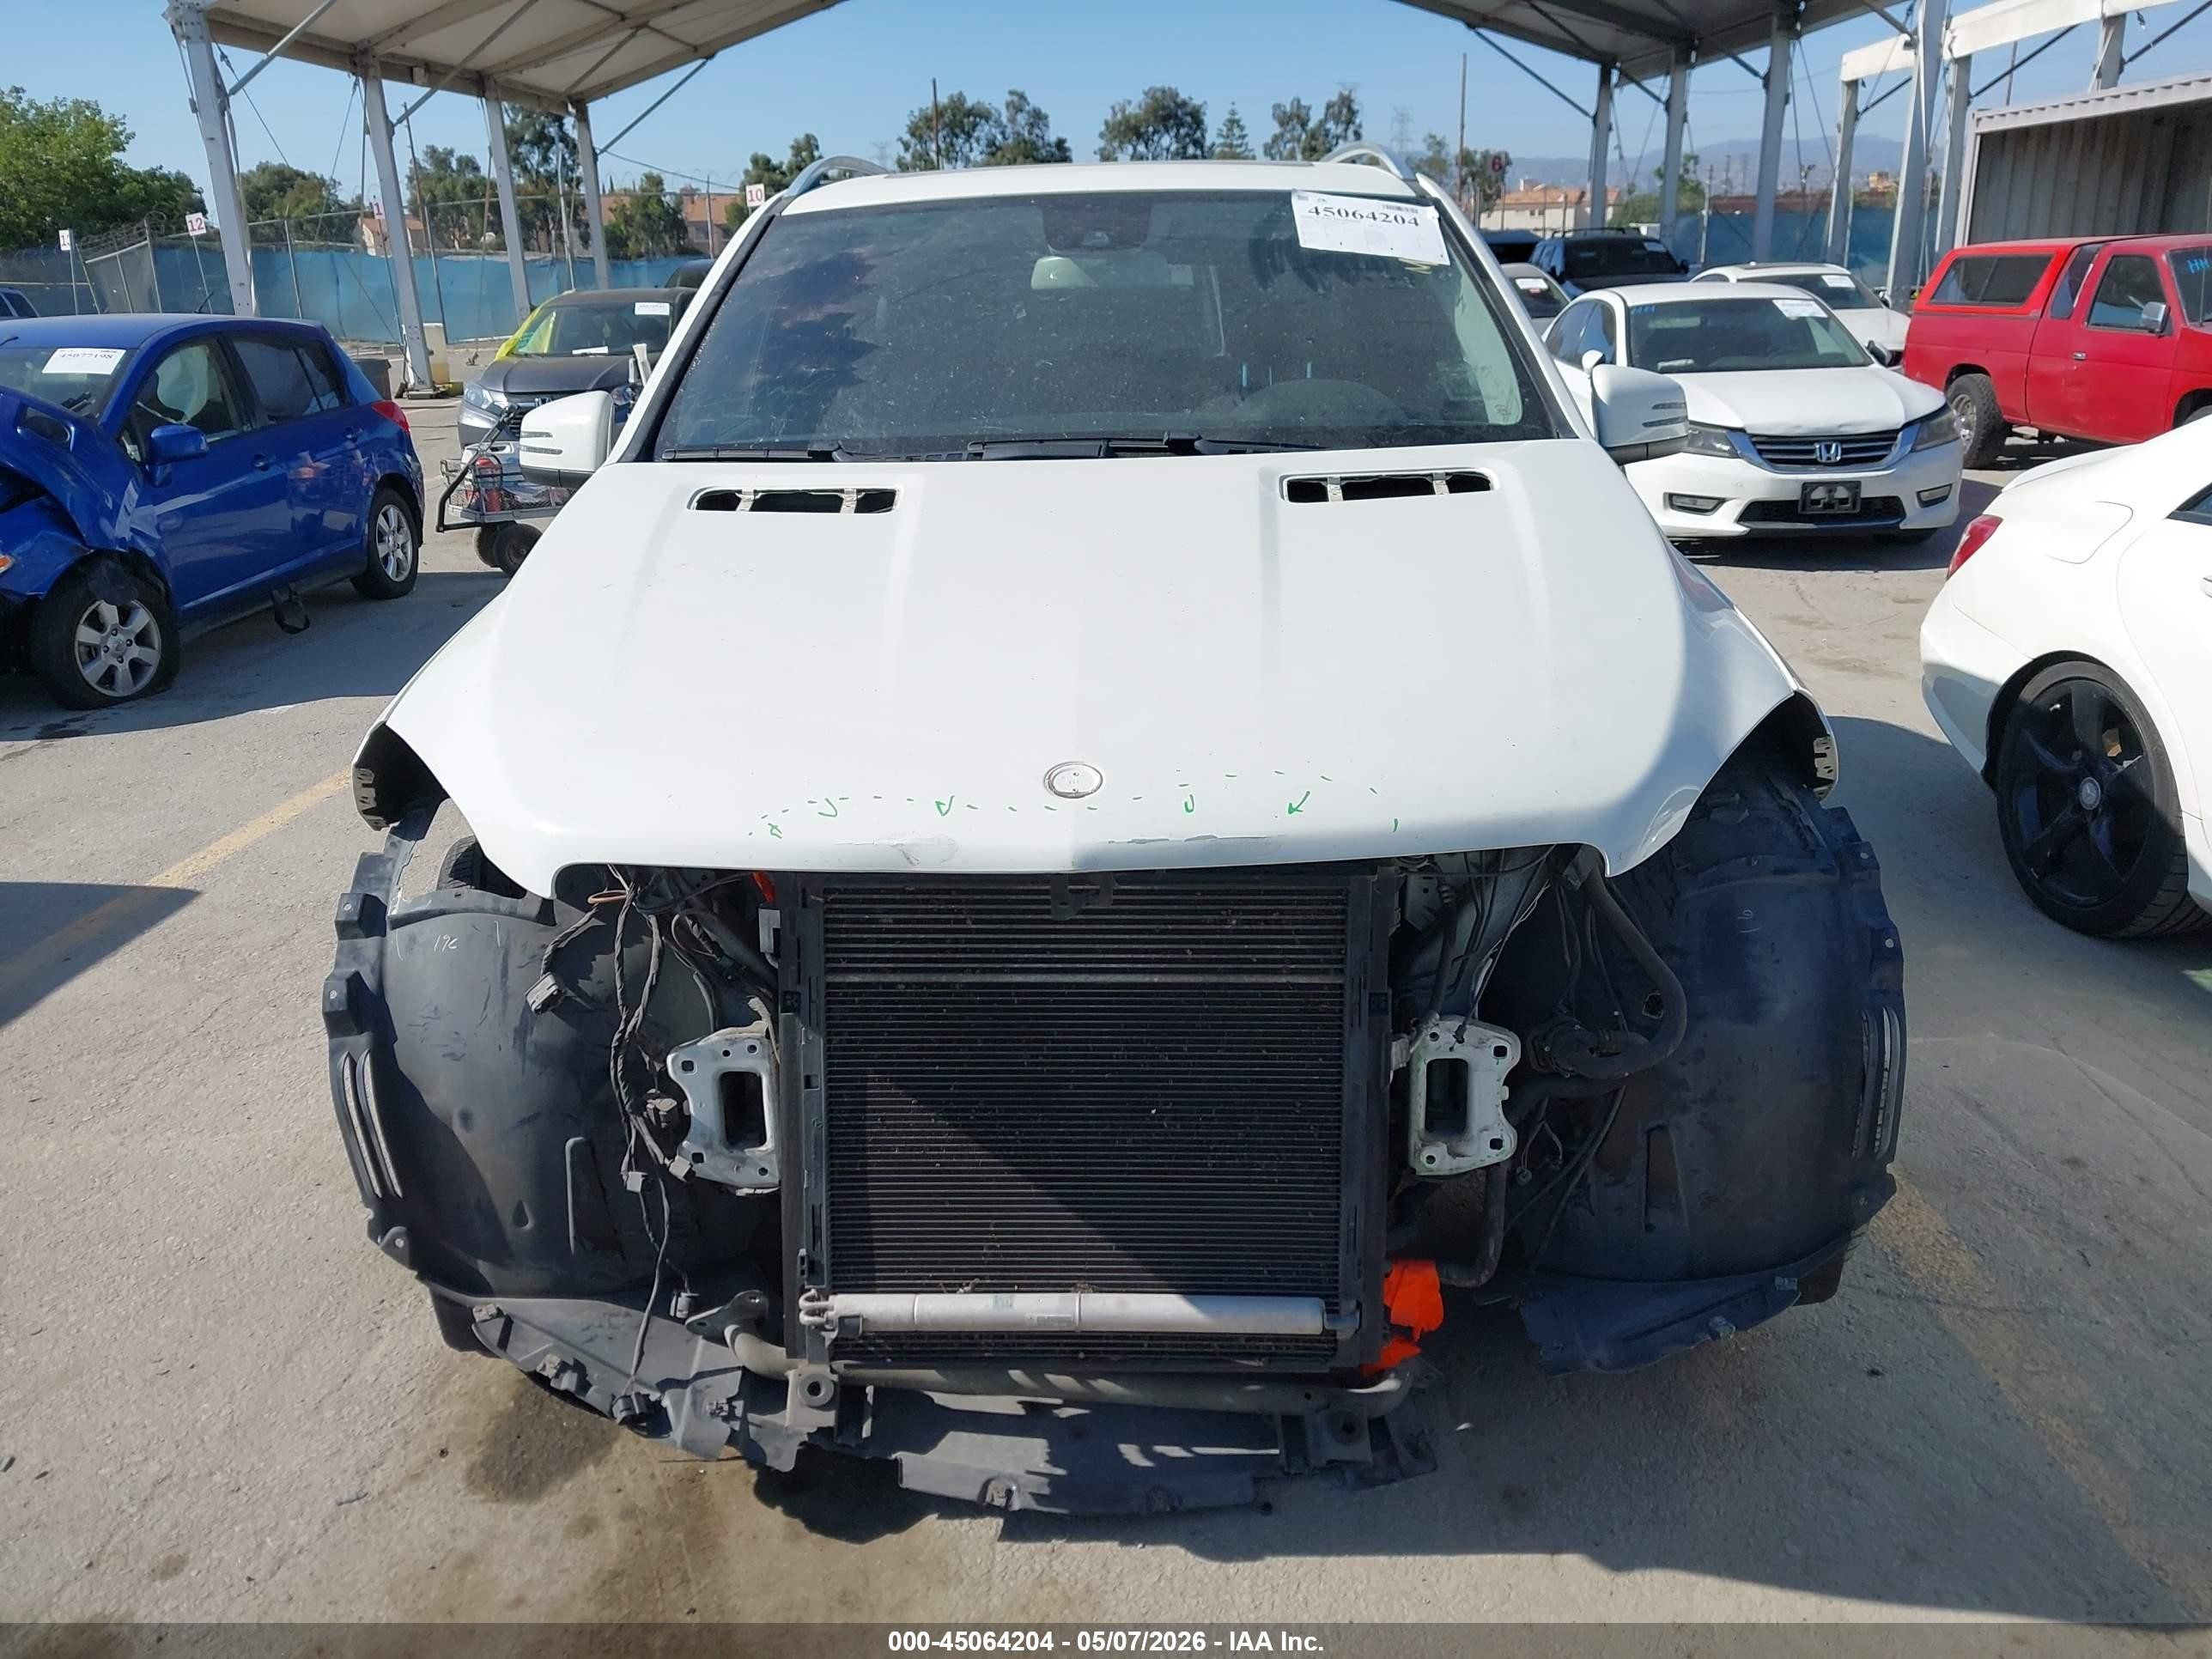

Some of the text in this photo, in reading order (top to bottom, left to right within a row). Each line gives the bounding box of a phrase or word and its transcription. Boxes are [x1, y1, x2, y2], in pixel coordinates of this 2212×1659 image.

[748, 189, 763, 202] 10
[1308, 205, 1419, 227] 45064204
[188, 217, 204, 231] 12
